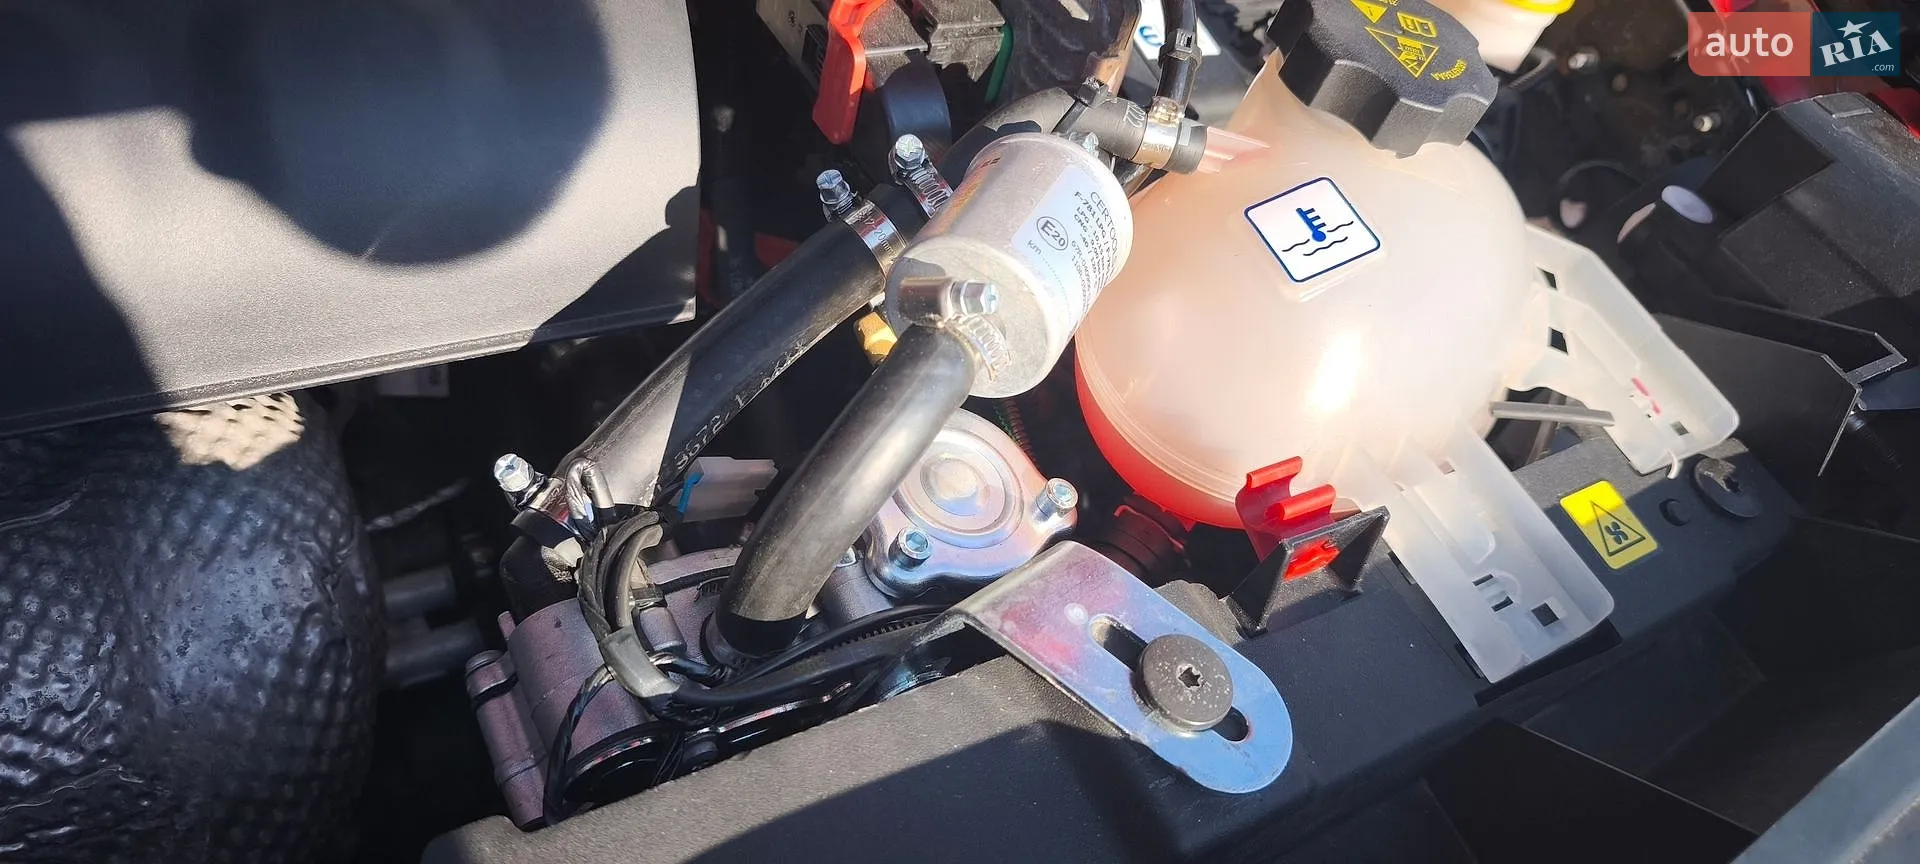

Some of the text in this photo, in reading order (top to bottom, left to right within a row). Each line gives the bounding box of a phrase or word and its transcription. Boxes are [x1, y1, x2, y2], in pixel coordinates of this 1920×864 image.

[1073, 214, 1088, 233] CNG
[1074, 191, 1096, 219] F-781
[1095, 217, 1107, 239] LPG
[1076, 206, 1090, 224] LPG
[1040, 219, 1066, 248] E20
